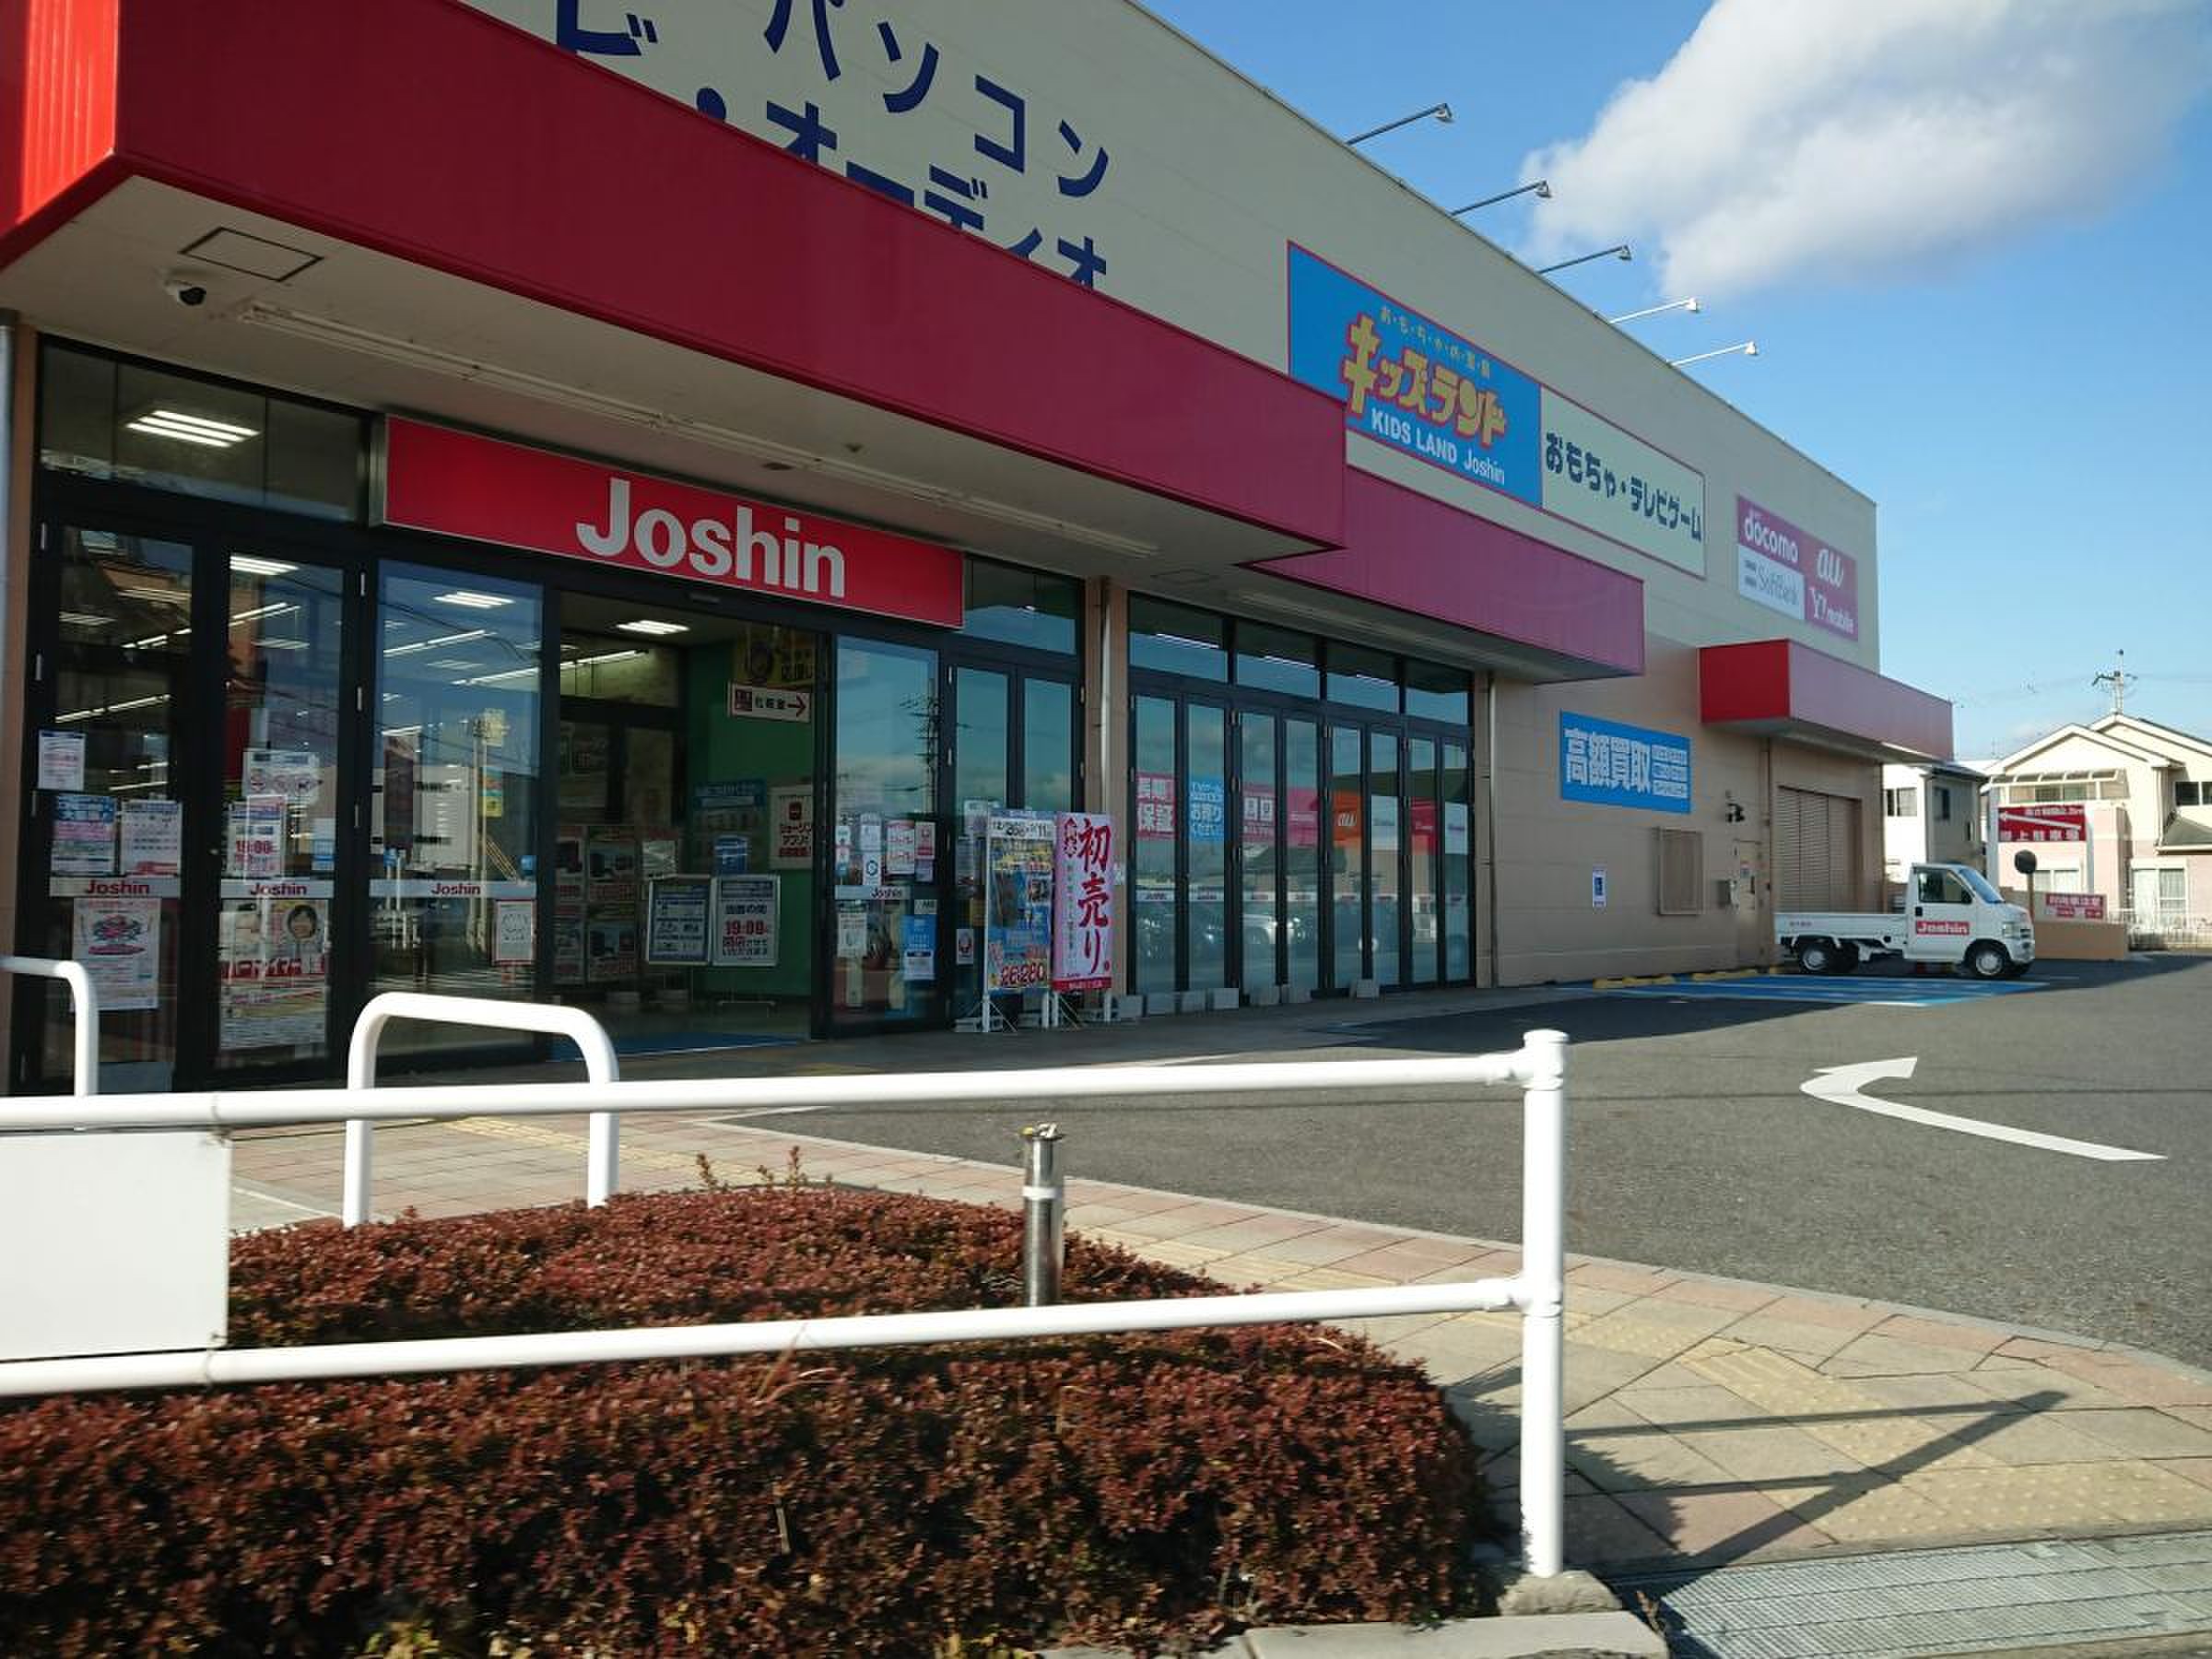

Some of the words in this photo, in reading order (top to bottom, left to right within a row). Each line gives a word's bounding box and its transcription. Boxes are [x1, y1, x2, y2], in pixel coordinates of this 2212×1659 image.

[1371, 407, 1411, 444] KIDS
[1416, 428, 1457, 464] LAND
[1464, 450, 1505, 486] Joshin
[1546, 431, 1702, 543] おもちゃ・テレビゲーム
[576, 477, 846, 598] Joshin
[1744, 509, 1798, 563] docomo
[1817, 548, 1844, 588] au
[84, 879, 149, 895] Joshin
[250, 883, 307, 896] Joshin
[431, 883, 481, 895] Joshin
[1917, 923, 1969, 934] Joshin
